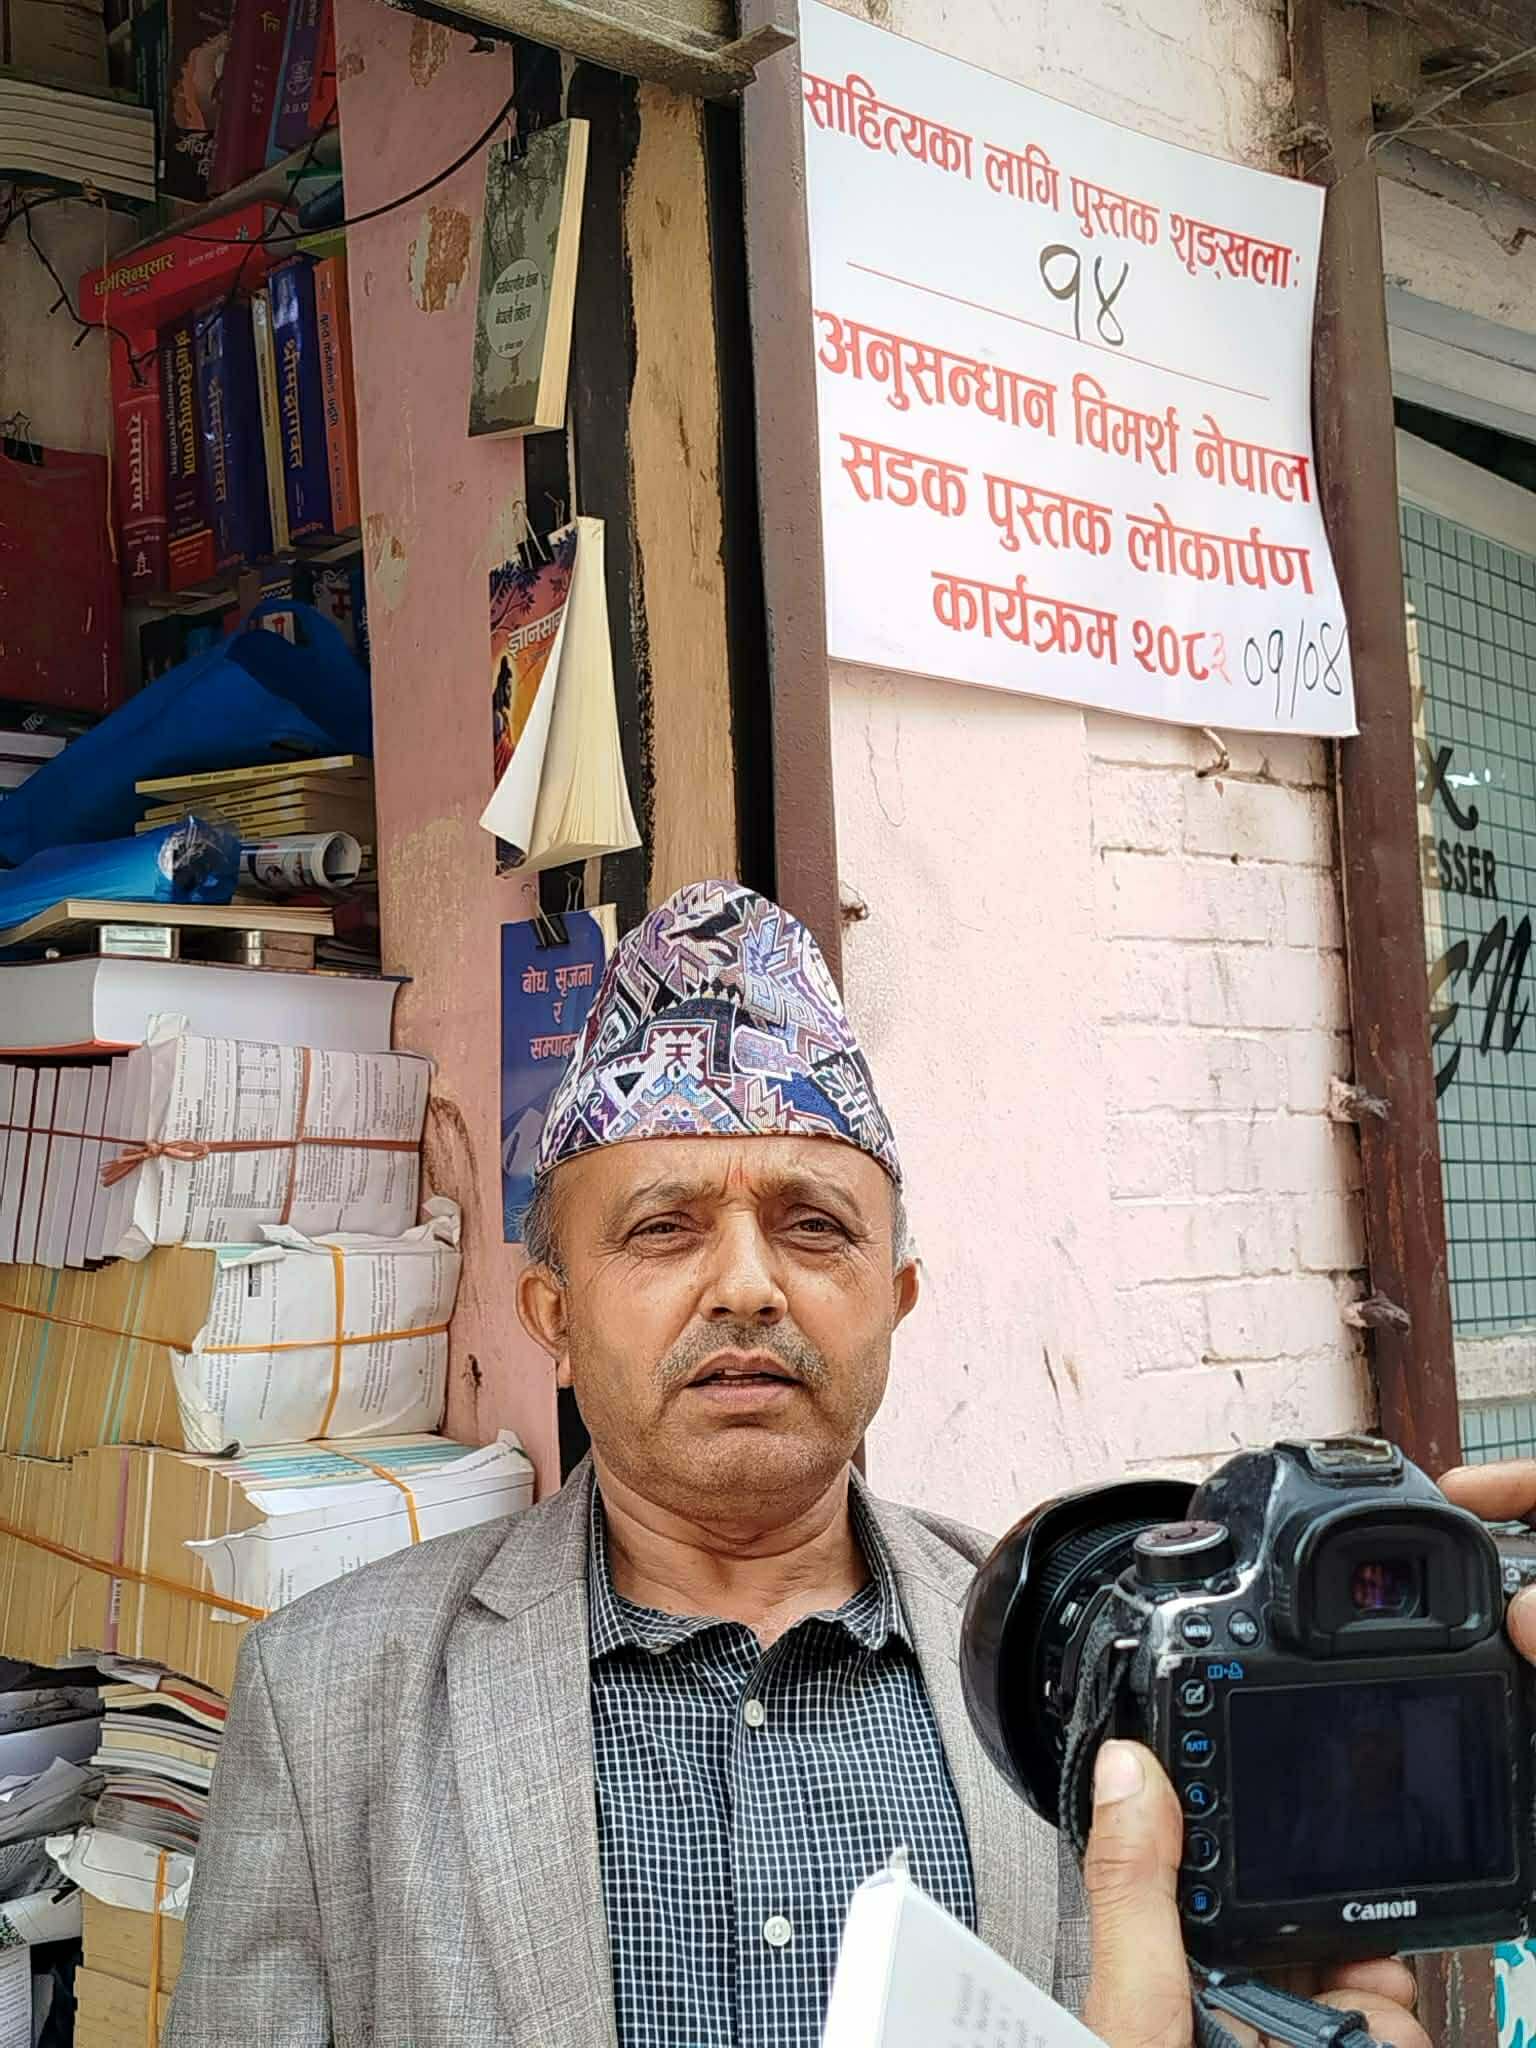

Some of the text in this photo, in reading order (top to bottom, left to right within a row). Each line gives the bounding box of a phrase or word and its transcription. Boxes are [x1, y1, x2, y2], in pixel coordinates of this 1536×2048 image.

[803, 73, 972, 179] साहित्यका
[984, 143, 1060, 212] लागि
[1070, 176, 1158, 244] पुस्तक
[1040, 244, 1129, 346] १४
[815, 310, 1313, 504] अनुसन्धान विमर्श नेपाल
[126, 411, 143, 512] रामायण
[839, 432, 1315, 594] सडक पुस्तक लोकार्पण
[931, 570, 1118, 665] कार्यक्रम
[552, 1002, 563, 1024] र
[554, 963, 594, 997] सृजना
[1184, 1624, 1211, 1638] MENU
[1186, 1739, 1209, 1752] RATE
[1342, 1899, 1417, 1922] Canon
